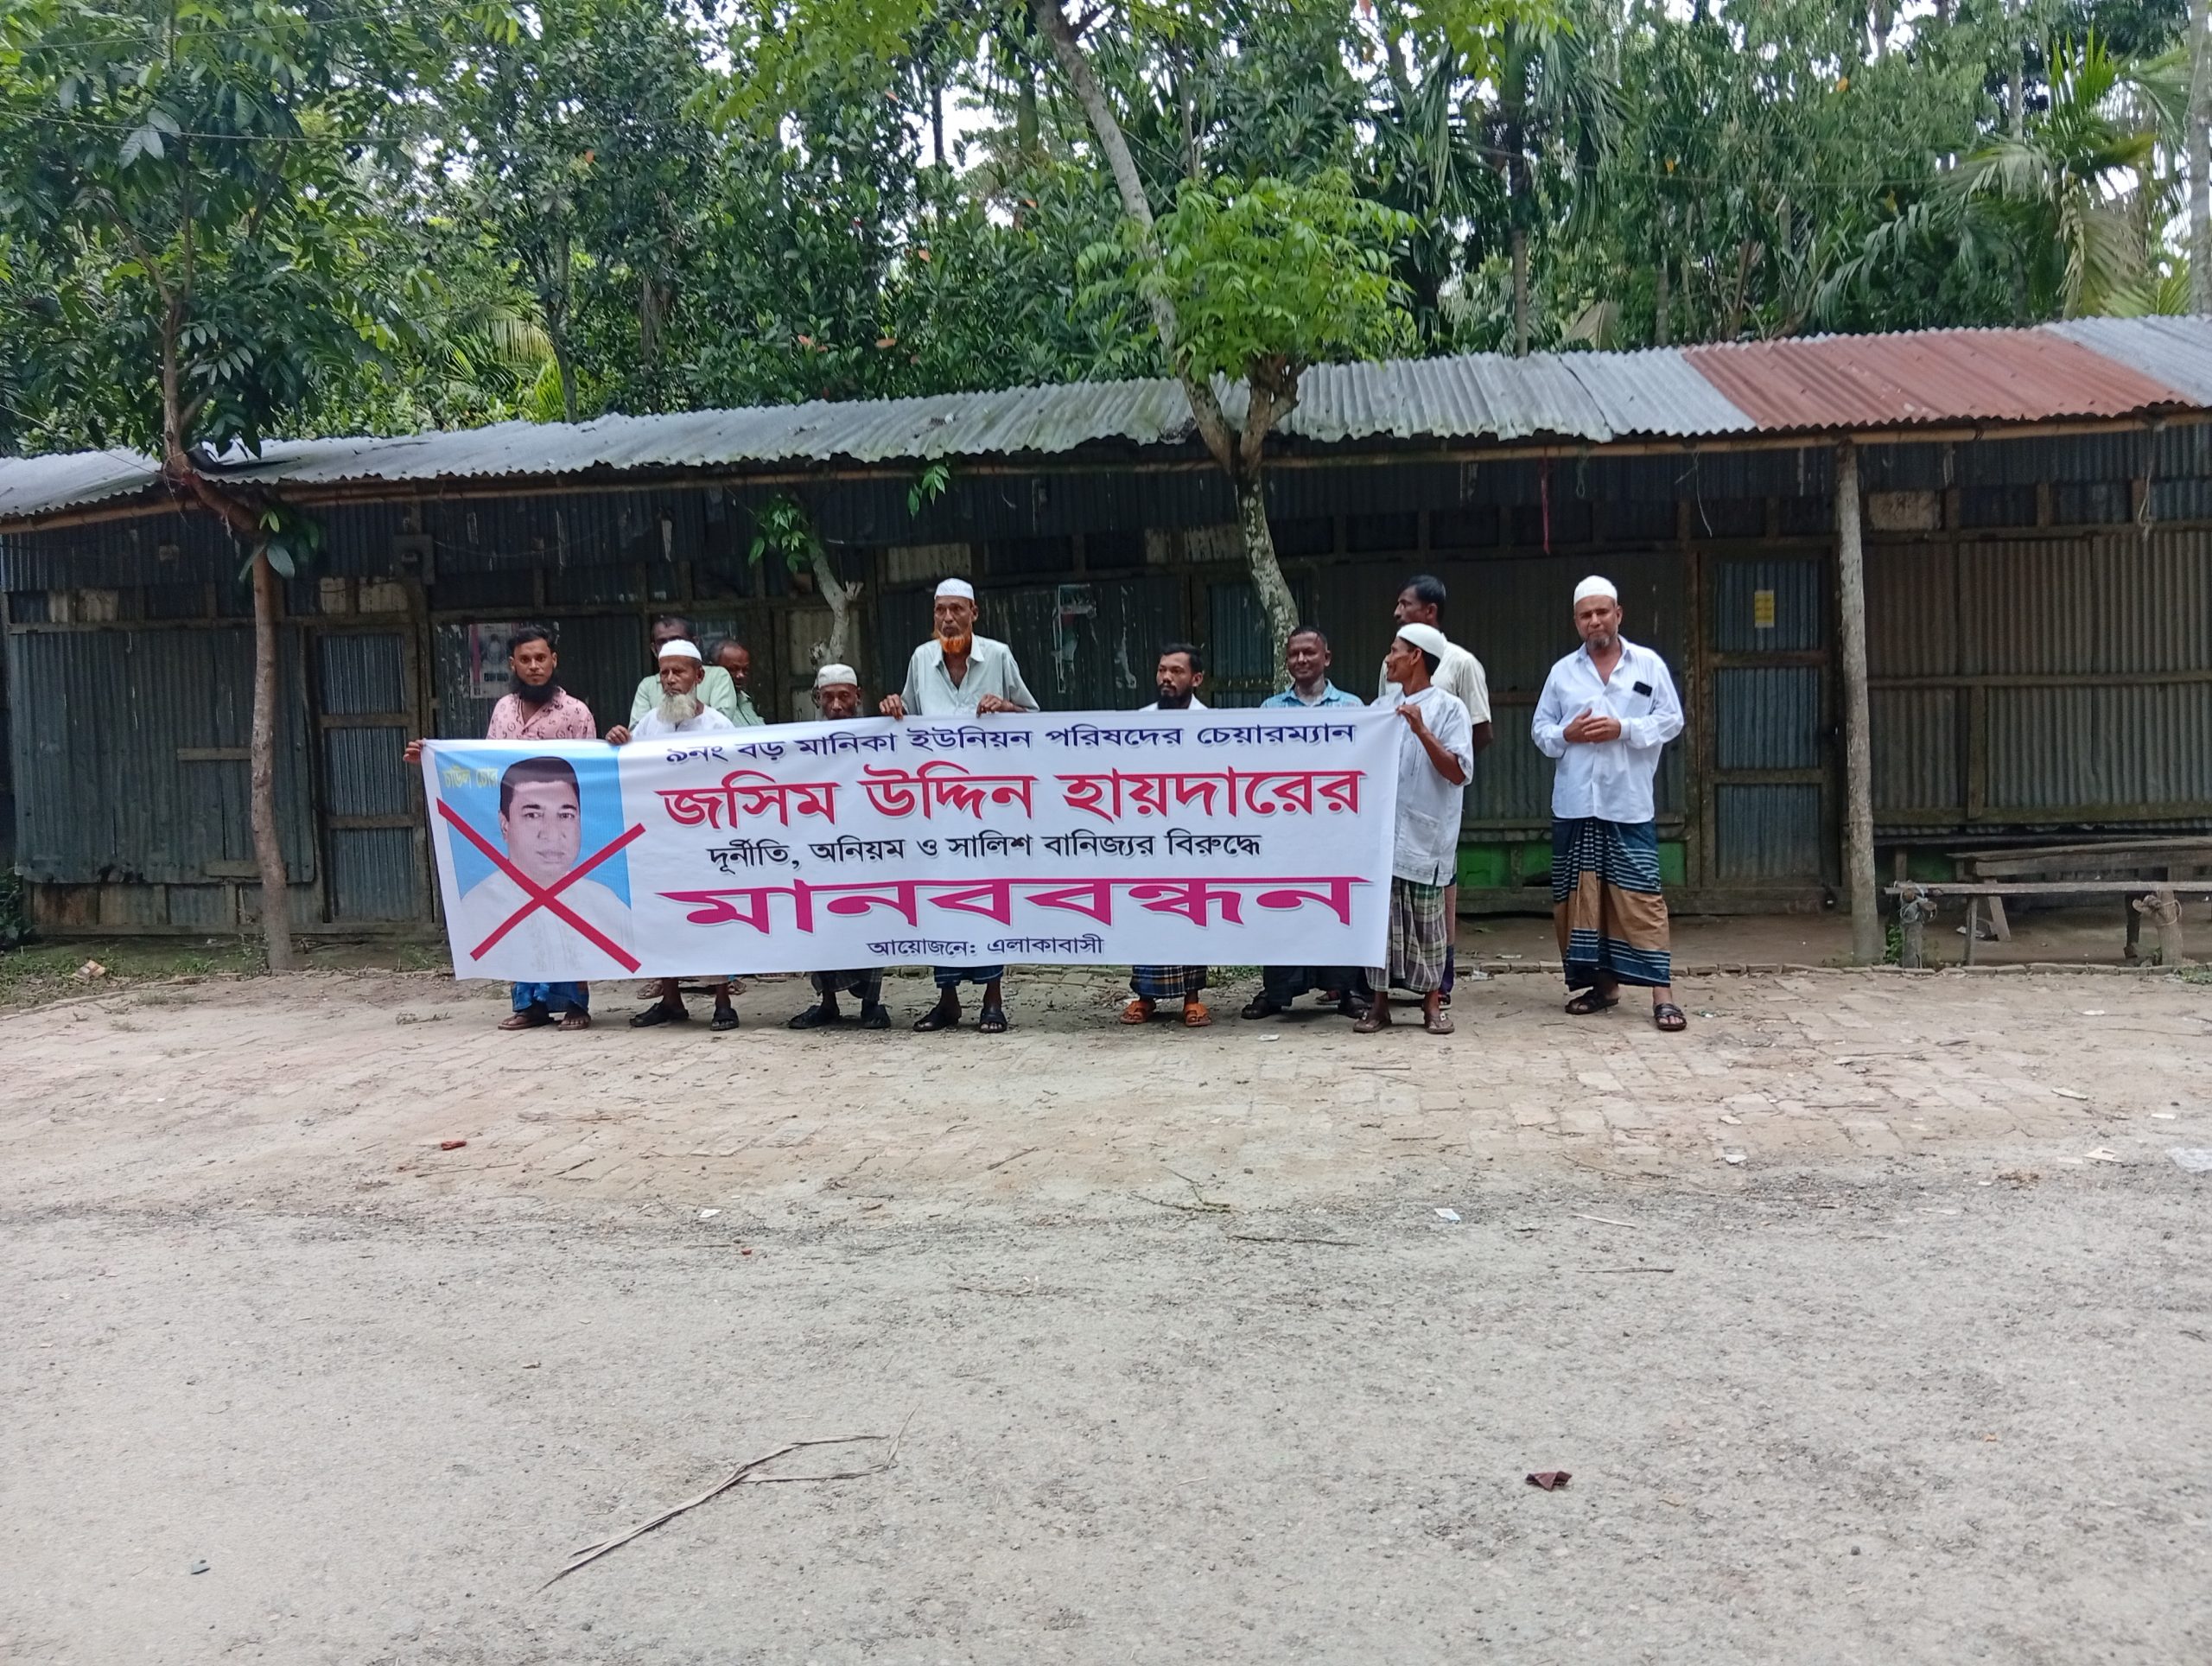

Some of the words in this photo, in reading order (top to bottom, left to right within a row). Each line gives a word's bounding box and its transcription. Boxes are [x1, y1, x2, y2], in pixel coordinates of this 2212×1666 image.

[666, 746, 728, 763] ৯নং
[738, 741, 785, 760] বড়
[794, 732, 898, 755] মানিকা
[906, 726, 1033, 749] ইউনিয়ন
[1046, 724, 1184, 747] পরিষদের
[1198, 723, 1356, 744] চেয়ারম্যান
[655, 771, 841, 829] জসিম
[857, 761, 1039, 820] উদ্দিন
[1054, 766, 1366, 824] হায়দারের
[706, 839, 799, 874] দূর্নীতি,
[808, 835, 906, 862] অনিয়ম
[917, 839, 937, 855] ও
[945, 830, 1033, 858] সালিশ
[1041, 829, 1155, 856] বানিজ্যর
[1164, 828, 1262, 855] বিরুদ্ধে
[655, 877, 1372, 935] মানববন্ধন
[867, 938, 975, 956] আয়োজনে:
[988, 933, 1104, 954] এলাকাবাসী
